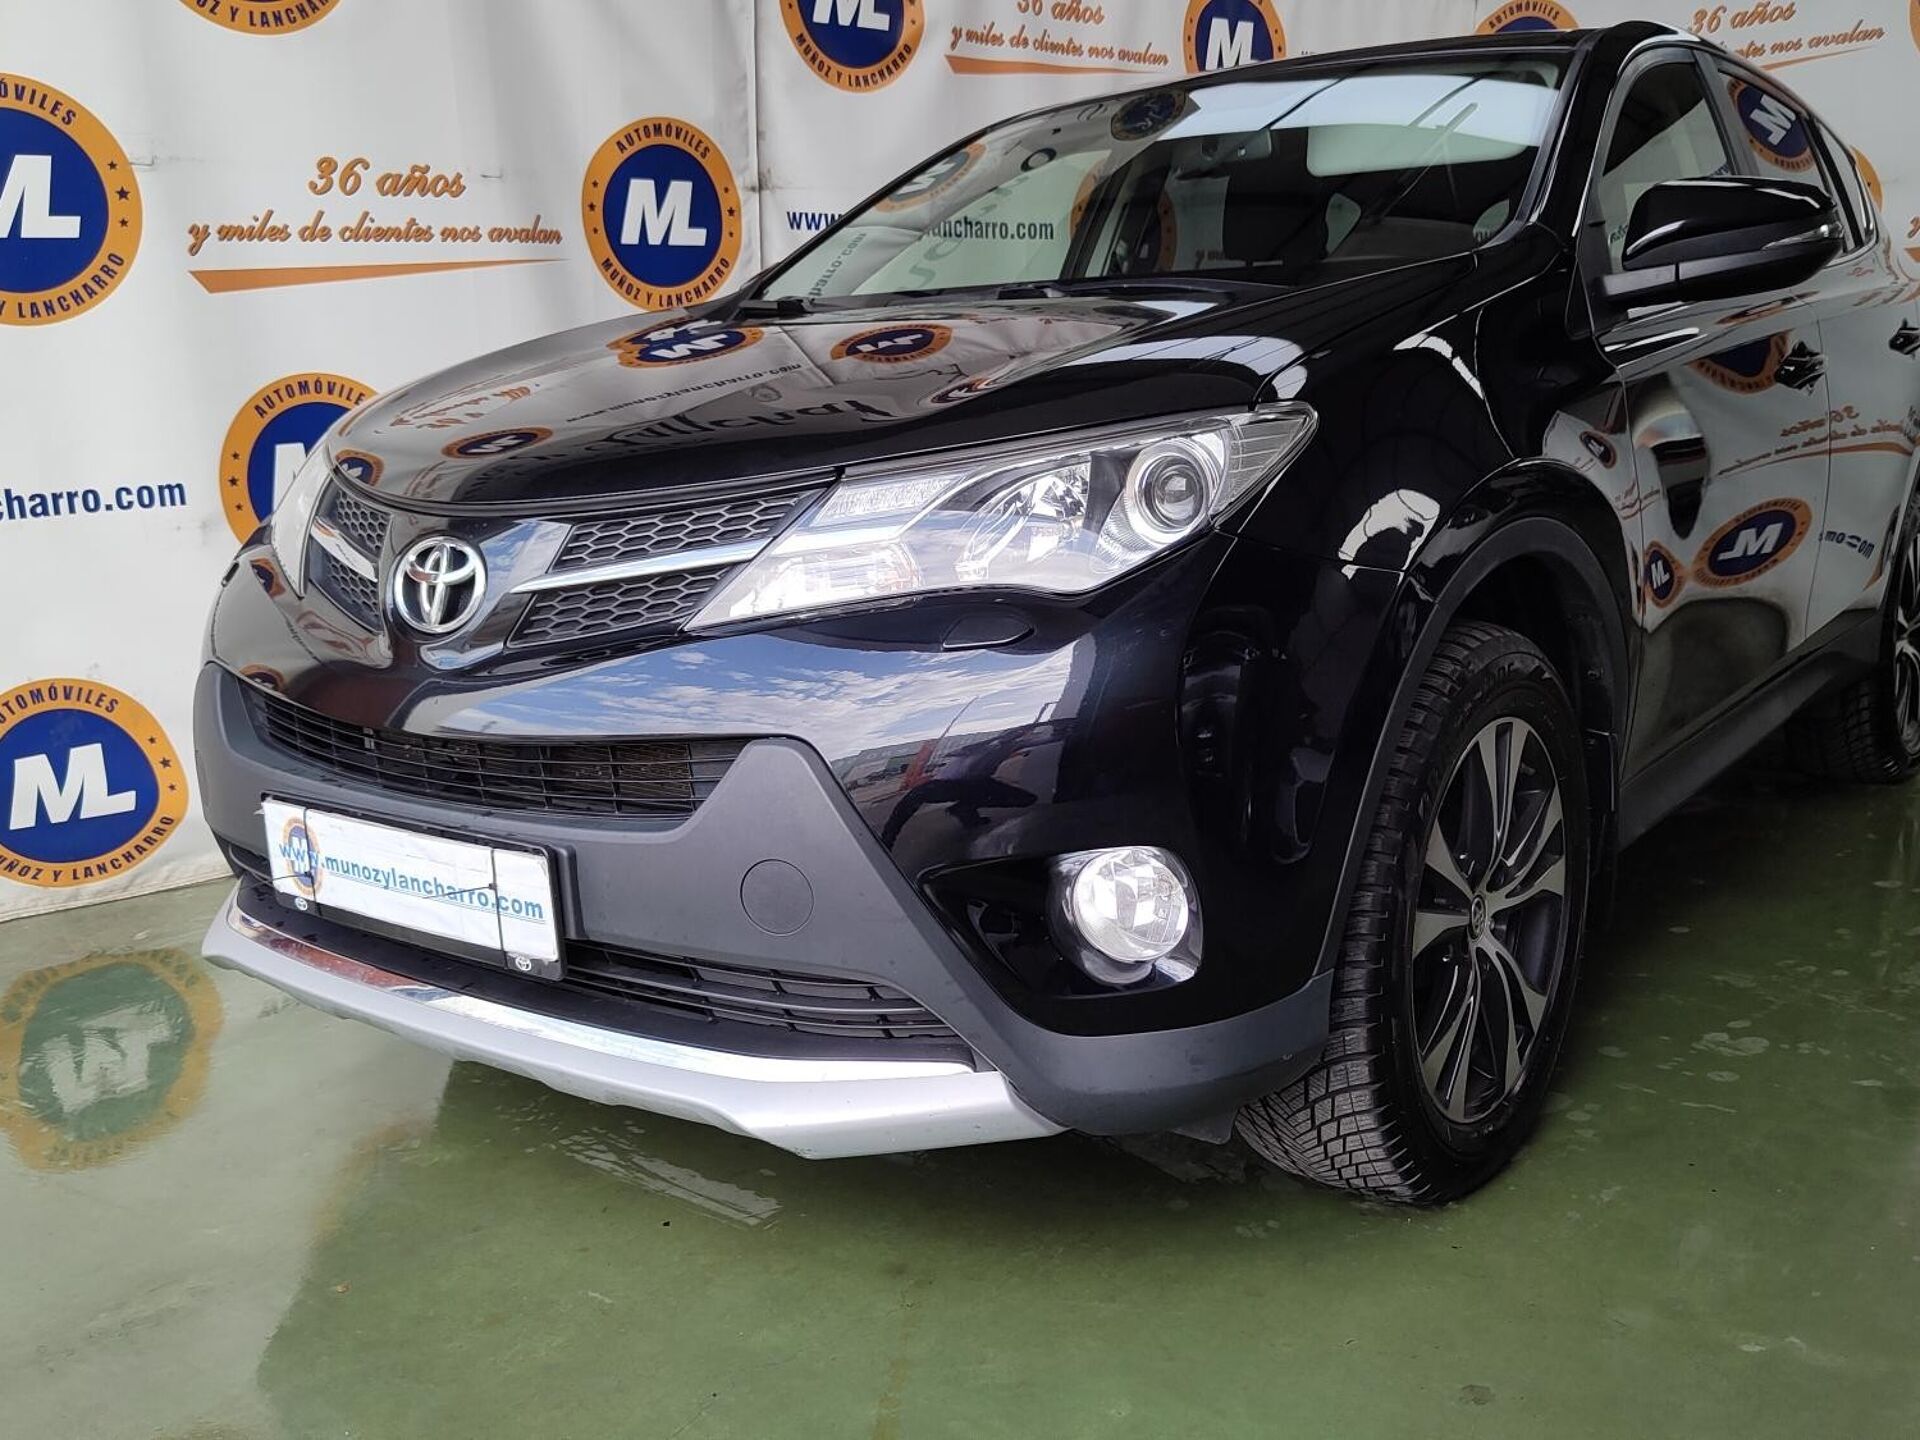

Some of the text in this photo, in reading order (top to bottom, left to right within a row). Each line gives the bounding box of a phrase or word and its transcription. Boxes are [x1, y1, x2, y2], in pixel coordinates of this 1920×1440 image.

[796, 32, 832, 78] MUÑOZ
[848, 43, 913, 87] LANCHARRO
[950, 22, 1170, 66] y miles de clientes nos avalan
[1770, 37, 1803, 55] nos
[1808, 19, 1886, 49] avalan
[0, 78, 77, 126] ÓVILES
[616, 122, 711, 159] AUTOMÓVILES
[308, 156, 467, 198] 36 años
[188, 209, 563, 256] y miles de clientes nos avalan
[620, 178, 707, 246] ML
[17, 252, 125, 319] LANCHARRO
[601, 257, 730, 308] MUÑOZ Y LANCHARRO
[254, 376, 367, 419] AUTOMÓVILE
[0, 481, 187, 521] harro.com
[0, 682, 119, 723] TOMÓVILES
[9, 742, 137, 830] ML
[53, 869, 62, 882] Y
[72, 816, 175, 880] LANCHARRO
